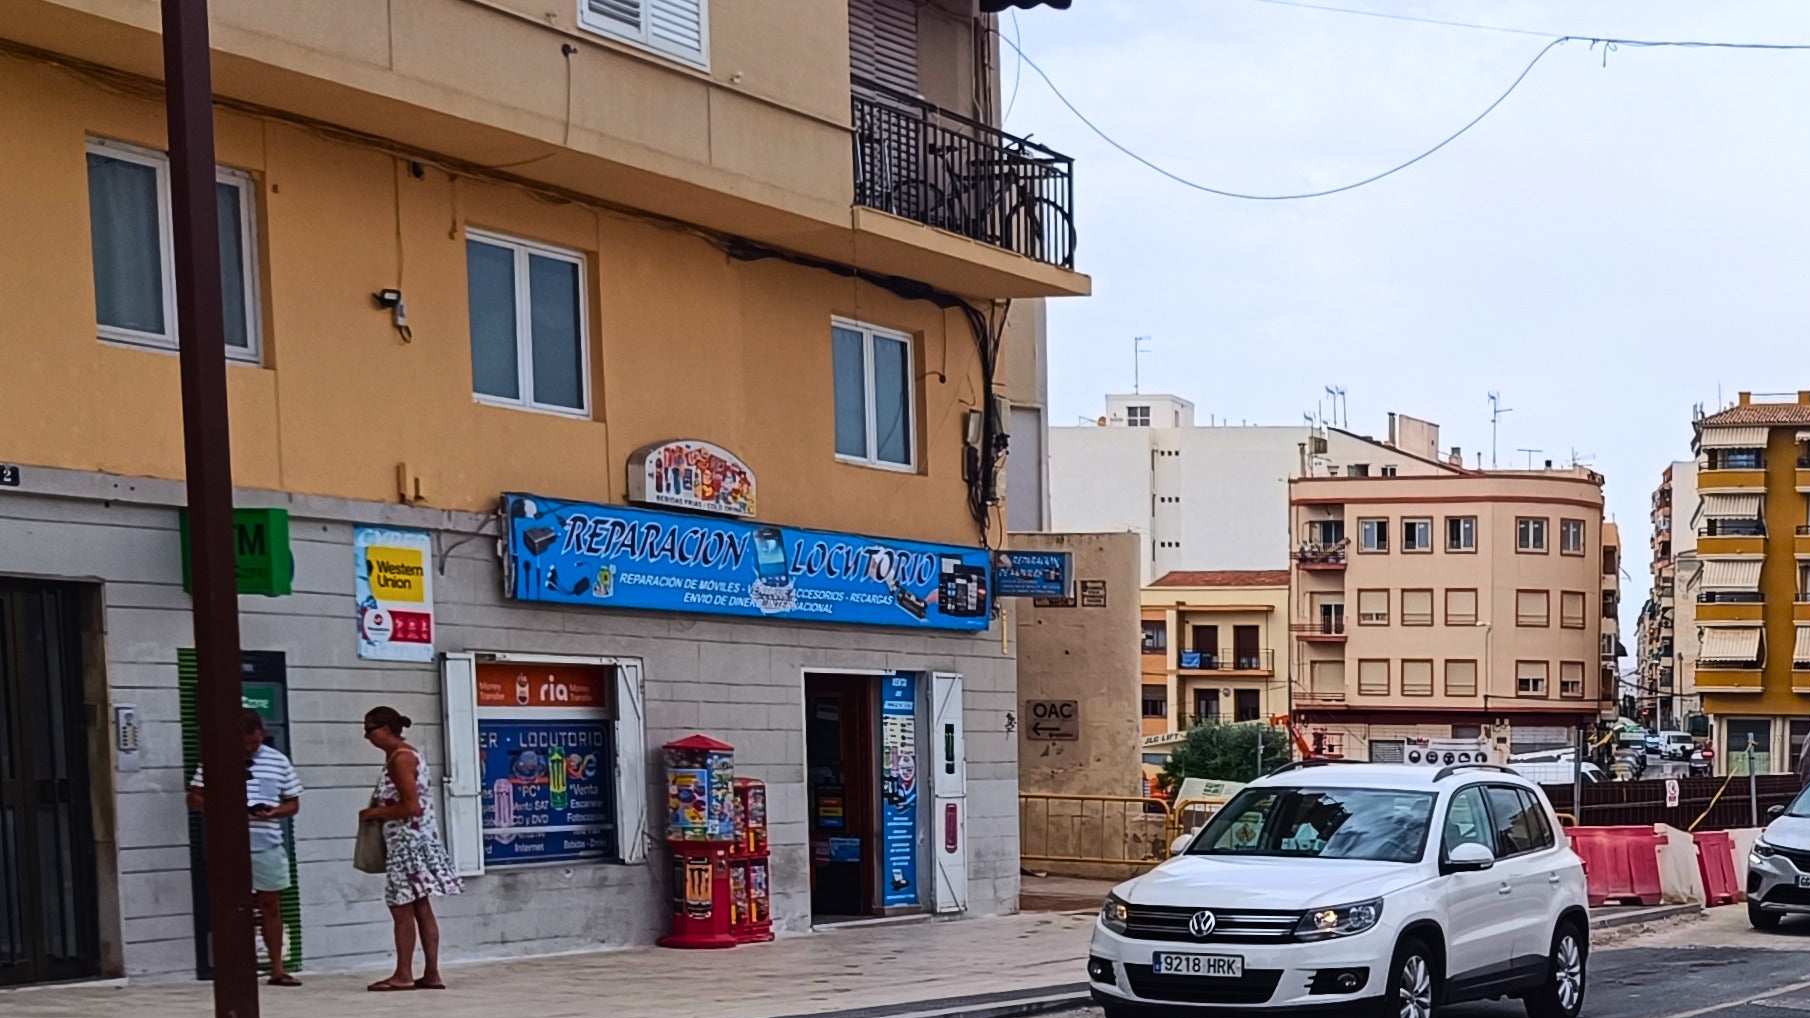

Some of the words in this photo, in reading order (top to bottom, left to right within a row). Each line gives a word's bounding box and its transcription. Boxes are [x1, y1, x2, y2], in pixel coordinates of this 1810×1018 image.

[3, 469, 12, 482] 2
[561, 514, 750, 571] REPARACION
[789, 538, 937, 587] LOCUTORIO
[376, 560, 424, 576] Western
[377, 574, 411, 589] Union
[620, 572, 682, 588] REPARACIÓN
[684, 578, 698, 589] DE
[700, 579, 740, 593] MÓVILES
[791, 587, 844, 601] ACCESORIOS
[850, 592, 893, 605] RECARGAS
[714, 594, 727, 605] DE
[729, 596, 761, 608] DINERO
[539, 674, 568, 702] ria
[1033, 703, 1072, 719] OAC
[519, 731, 602, 748] LOCUTORIO
[514, 843, 545, 852] Internet
[1164, 955, 1201, 973] 9218
[1207, 958, 1236, 975] HRK
